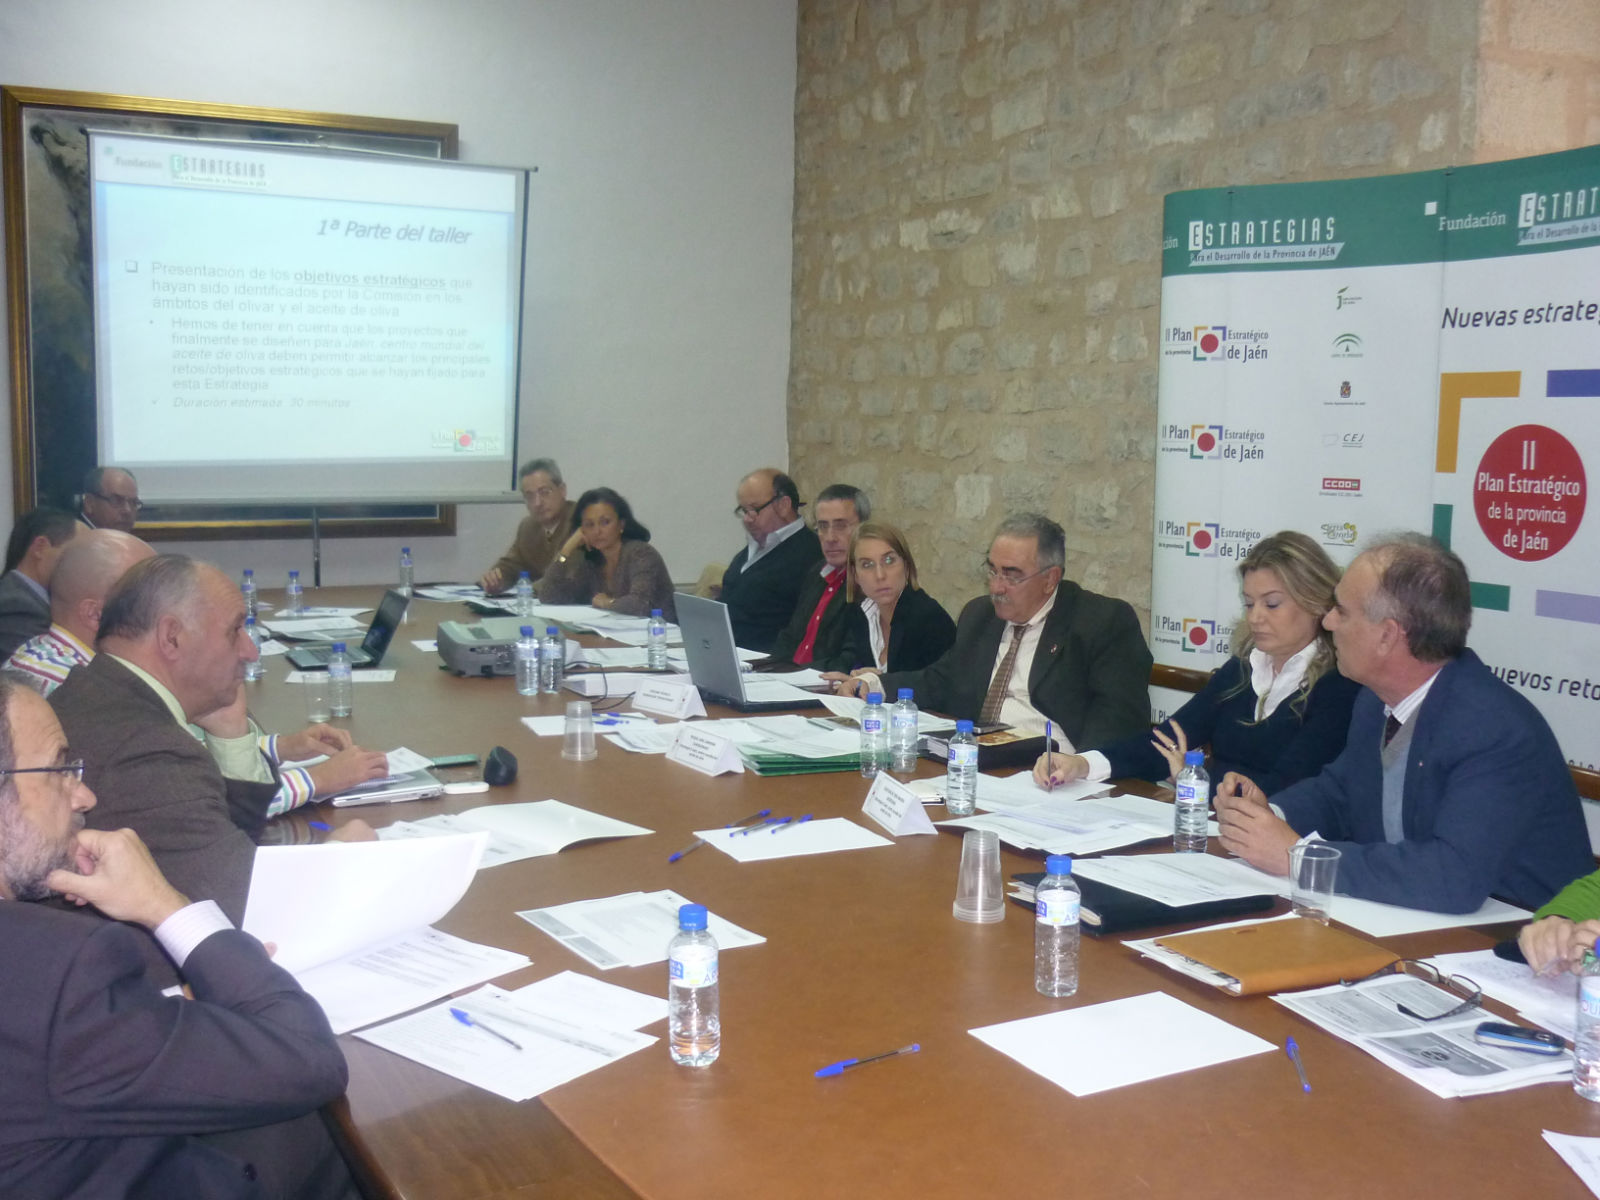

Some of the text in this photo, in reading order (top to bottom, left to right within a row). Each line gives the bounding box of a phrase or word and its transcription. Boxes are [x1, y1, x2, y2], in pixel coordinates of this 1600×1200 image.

[1438, 211, 1507, 231] Fundación
[1537, 229, 1544, 239] el
[1546, 226, 1580, 239] Desarrollo
[1581, 224, 1590, 235] de
[1590, 223, 1598, 233] la
[316, 219, 472, 244] 1ª Parte del taller
[1189, 217, 1336, 251] ESTRATEGIAS
[1207, 252, 1213, 261] el
[1215, 249, 1251, 261] Desarrollo
[1253, 249, 1261, 259] de
[1264, 249, 1270, 259] la
[1273, 247, 1306, 258] Provincia
[1308, 247, 1317, 257] de
[151, 261, 472, 289] Presentación de los objetivos estratégicos que
[151, 279, 463, 304] hayan sido identificados por la Comisión en los
[151, 296, 400, 317] ámbitos del olivar y el aceite de oliva
[1441, 300, 1600, 329] Nuevas estrate
[171, 318, 218, 331] Hemos
[222, 319, 238, 331] de
[241, 320, 273, 332] tener
[278, 322, 294, 332] en
[297, 323, 338, 335] cuenta
[1165, 327, 1268, 343] II Plan Estratégico
[171, 332, 241, 346] finalmente
[1227, 345, 1241, 359] de
[1243, 345, 1268, 363] Jaén
[1162, 424, 1265, 442] II Plan Estratégico
[1223, 444, 1237, 459] de
[1238, 443, 1264, 463] Jaén
[1522, 440, 1536, 470] II
[1478, 472, 1580, 501] Plan Estratégico
[1488, 501, 1566, 526] de la provincia
[1159, 520, 1261, 541] II Plan Estratégico
[1220, 543, 1233, 557] de
[1503, 528, 1549, 554] de Jaén
[1155, 615, 1160, 629] II
[1162, 616, 1181, 632] Plan
[1216, 639, 1229, 653] de
